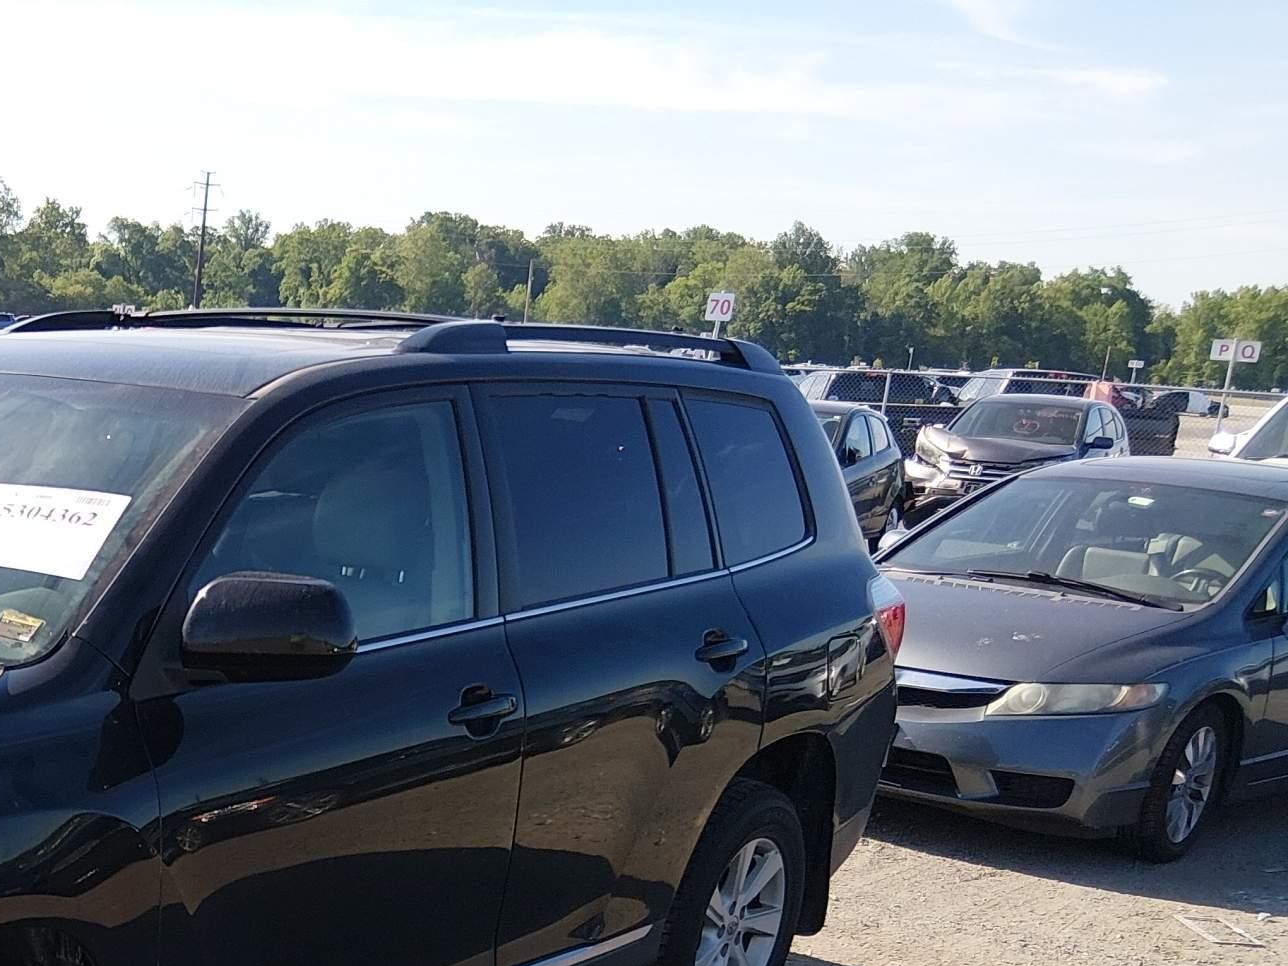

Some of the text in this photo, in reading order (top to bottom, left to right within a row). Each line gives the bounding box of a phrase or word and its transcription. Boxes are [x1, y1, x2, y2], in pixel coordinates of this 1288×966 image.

[709, 298, 731, 316] 70
[1218, 344, 1256, 359] P Q
